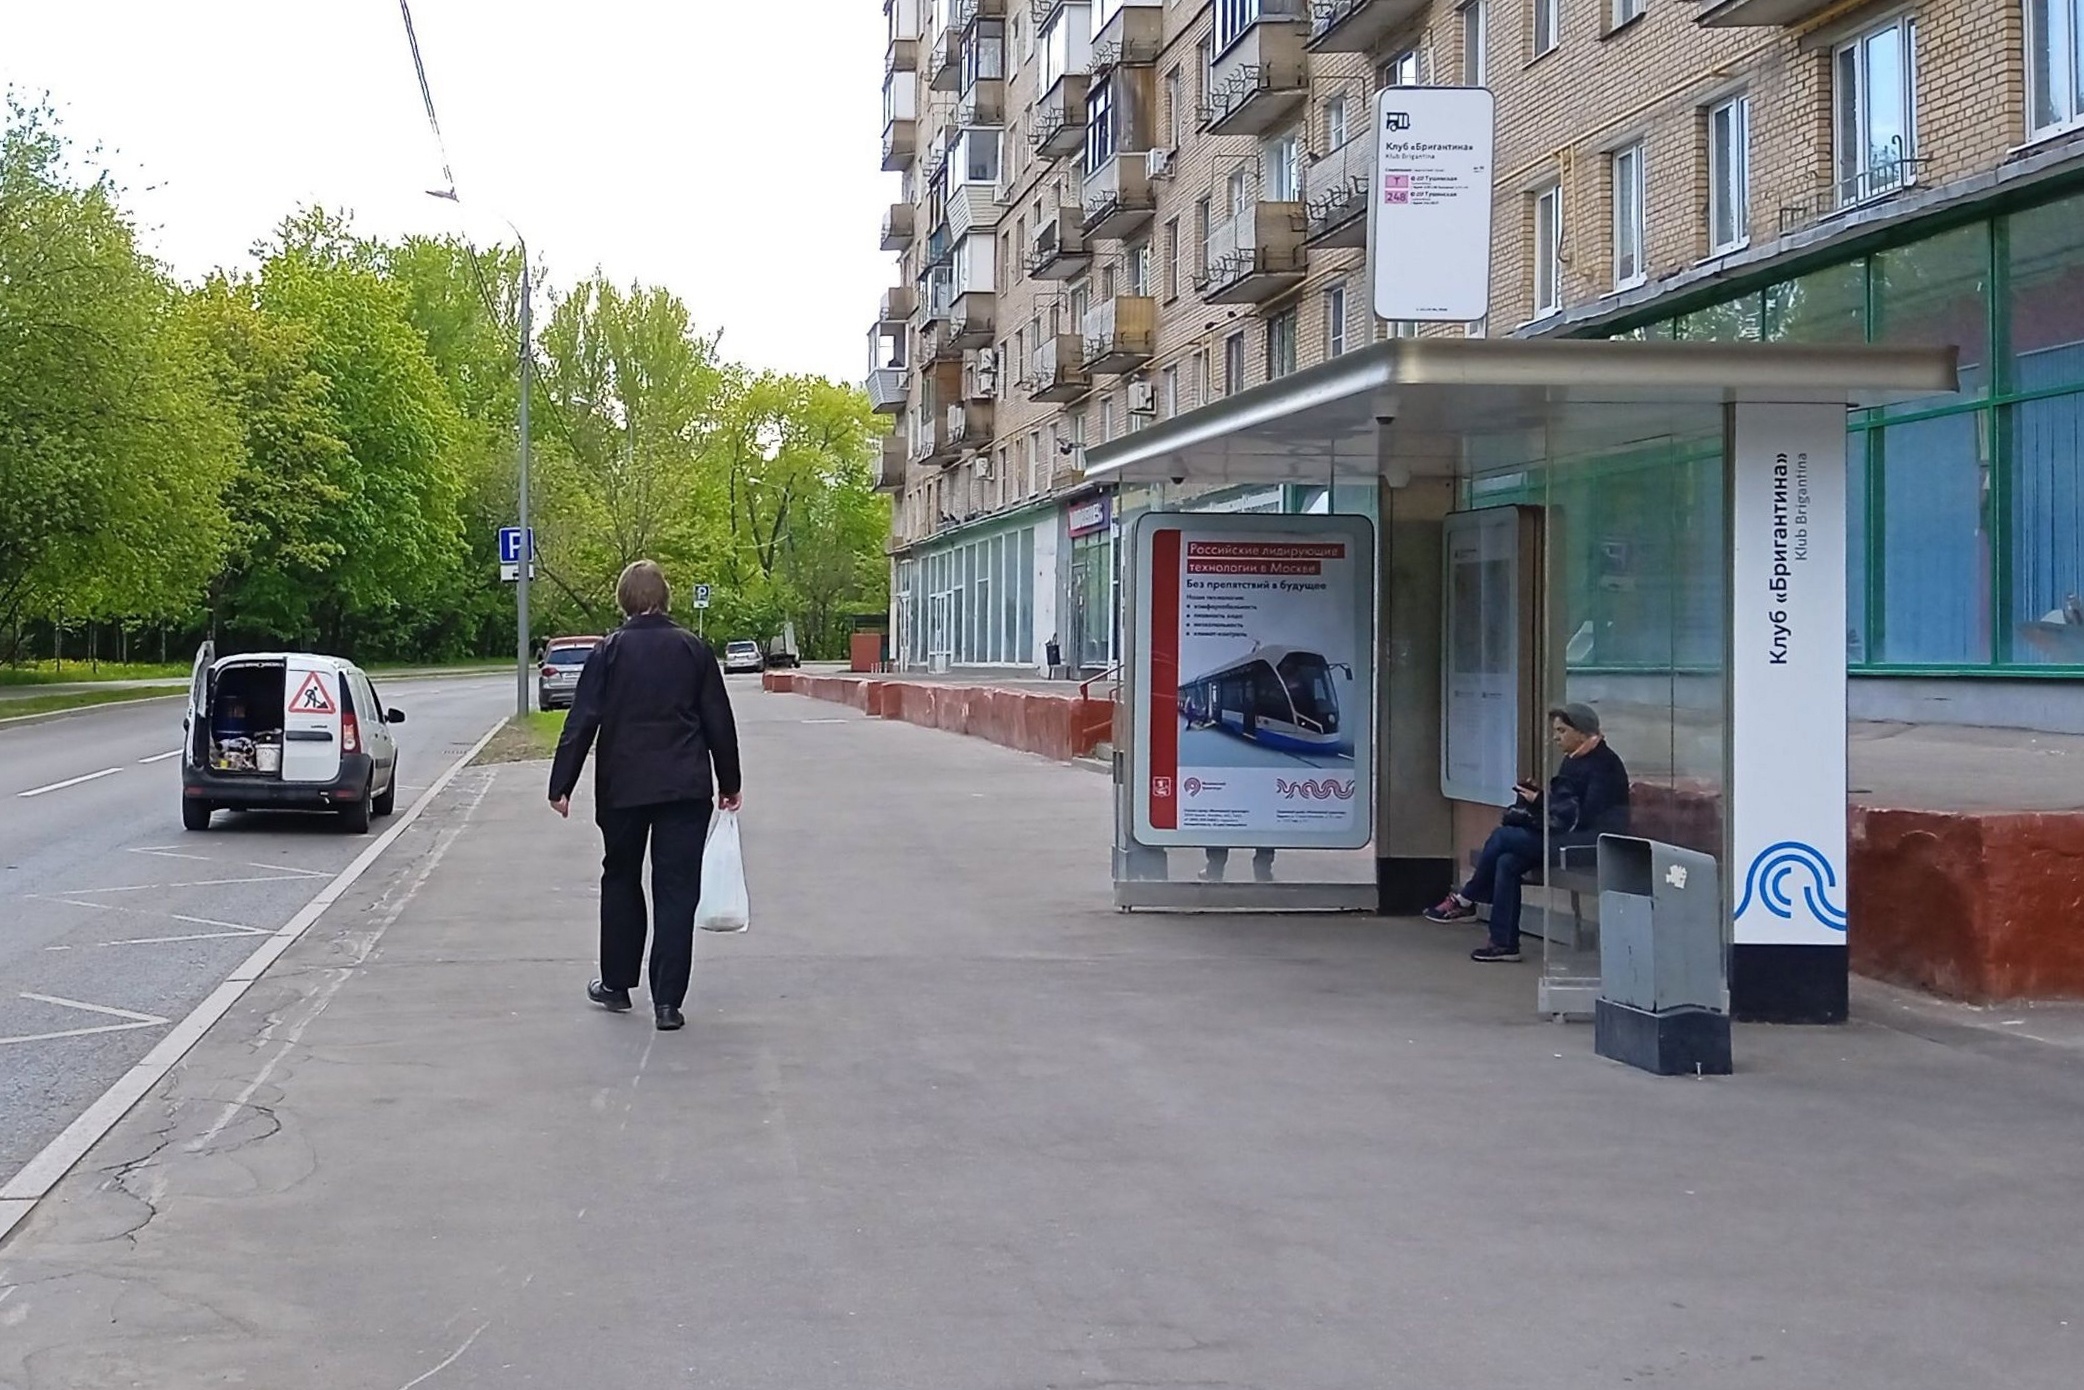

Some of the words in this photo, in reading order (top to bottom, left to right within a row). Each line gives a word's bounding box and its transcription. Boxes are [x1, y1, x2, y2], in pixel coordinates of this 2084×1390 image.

[1386, 142, 1409, 152] Клуб
[1411, 142, 1473, 152] «Бригантина»
[1387, 193, 1406, 202] 248
[1795, 452, 1810, 525] Brigantina
[1769, 453, 1791, 603] «Бригантина»
[1190, 543, 1259, 555] Российские
[1262, 547, 1338, 558] лидирующие
[1795, 528, 1808, 561] Klub
[1189, 563, 1257, 573] технологии
[1261, 565, 1267, 573] в
[1270, 563, 1316, 574] Москве
[1186, 579, 1204, 588] Без
[1207, 580, 1270, 590] препятствий
[1280, 580, 1327, 592] будущее
[698, 587, 707, 600] P
[1769, 611, 1791, 664] Клуб
